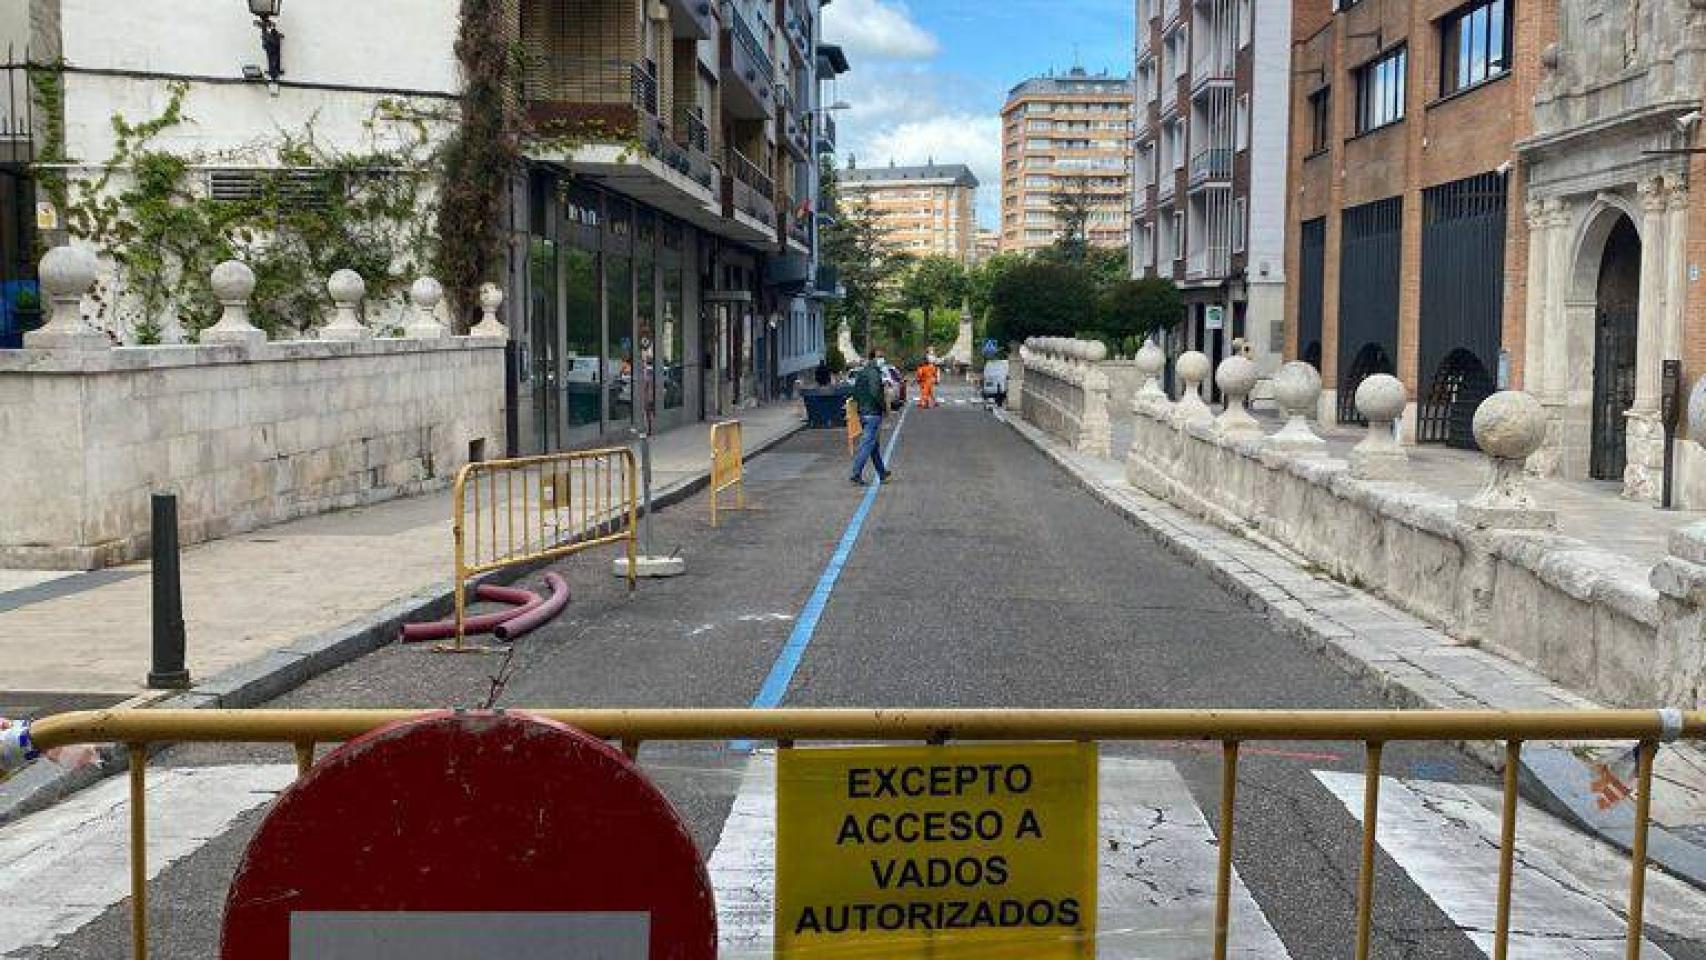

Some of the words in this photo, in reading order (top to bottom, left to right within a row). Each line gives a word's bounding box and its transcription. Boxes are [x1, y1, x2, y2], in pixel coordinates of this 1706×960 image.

[848, 764, 1032, 798] EXCEPTO
[837, 810, 1003, 845] ACCESO
[1015, 808, 1042, 839] A
[871, 856, 1009, 890] VADOS
[795, 898, 1080, 934] AUTORIZADOS
